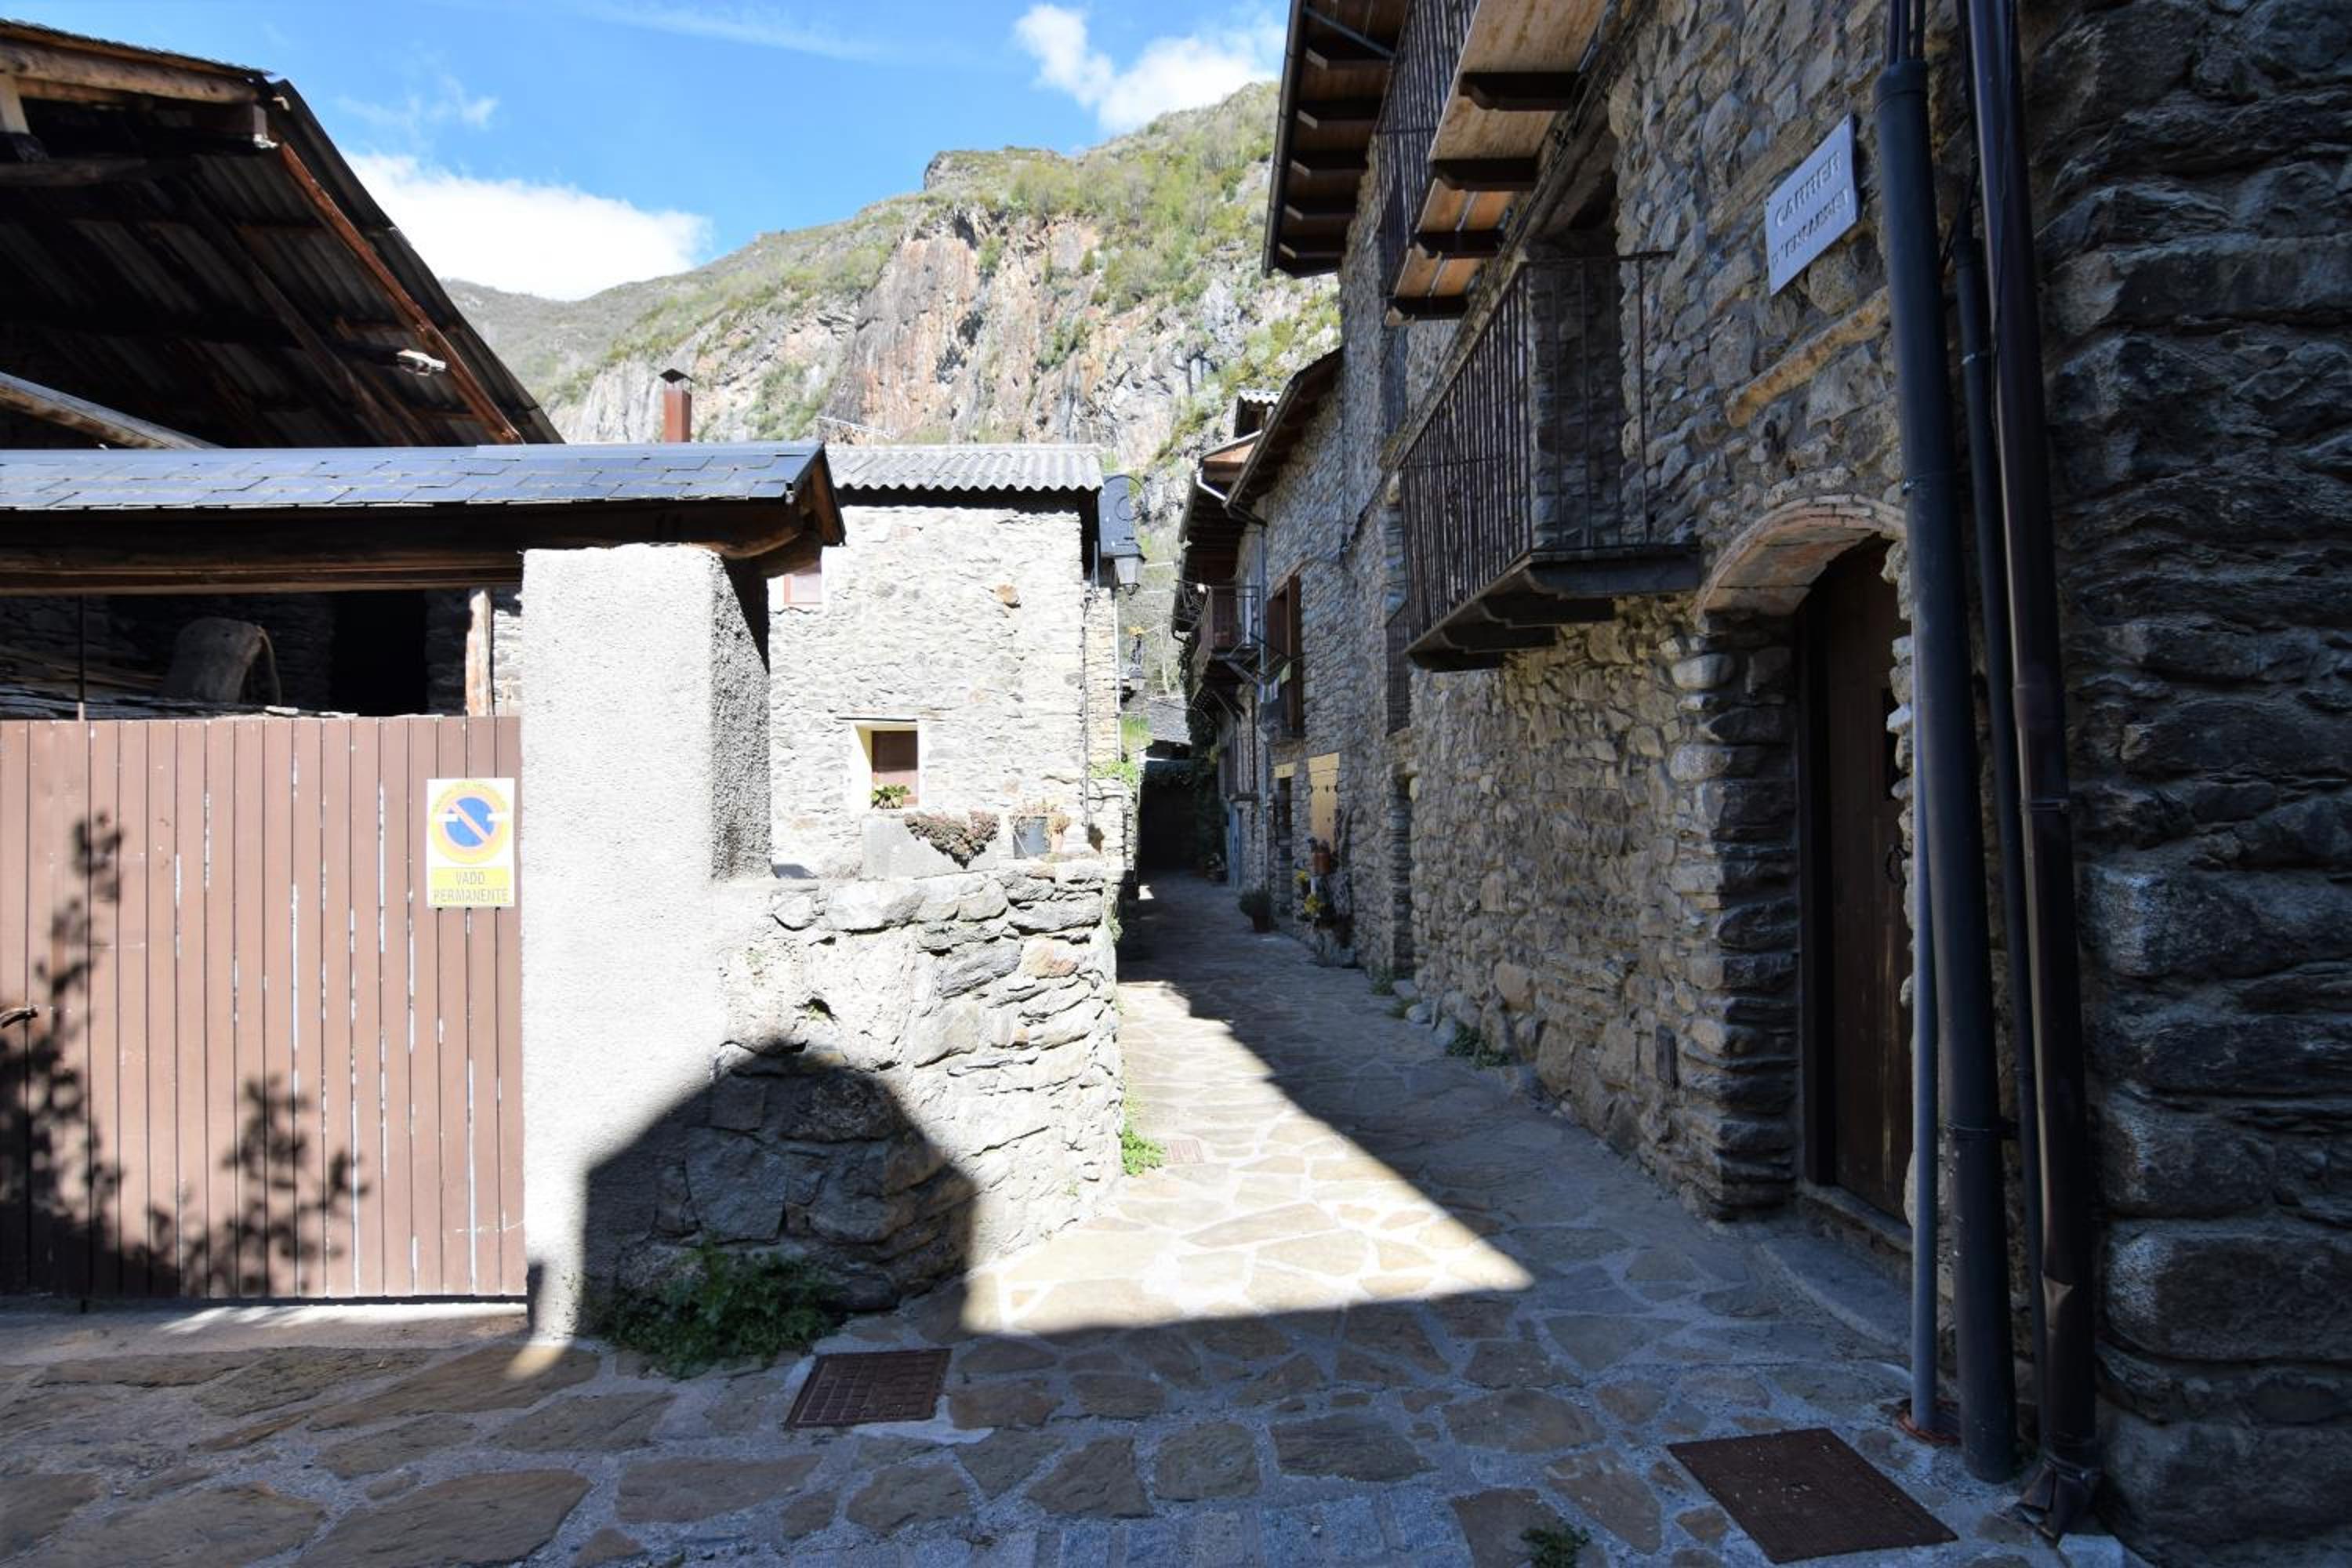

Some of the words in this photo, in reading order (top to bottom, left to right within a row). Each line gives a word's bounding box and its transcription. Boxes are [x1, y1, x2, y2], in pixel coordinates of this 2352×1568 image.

[1775, 151, 1841, 227] CARRER
[456, 871, 485, 885] VADO
[434, 888, 509, 902] PERMANENTE
